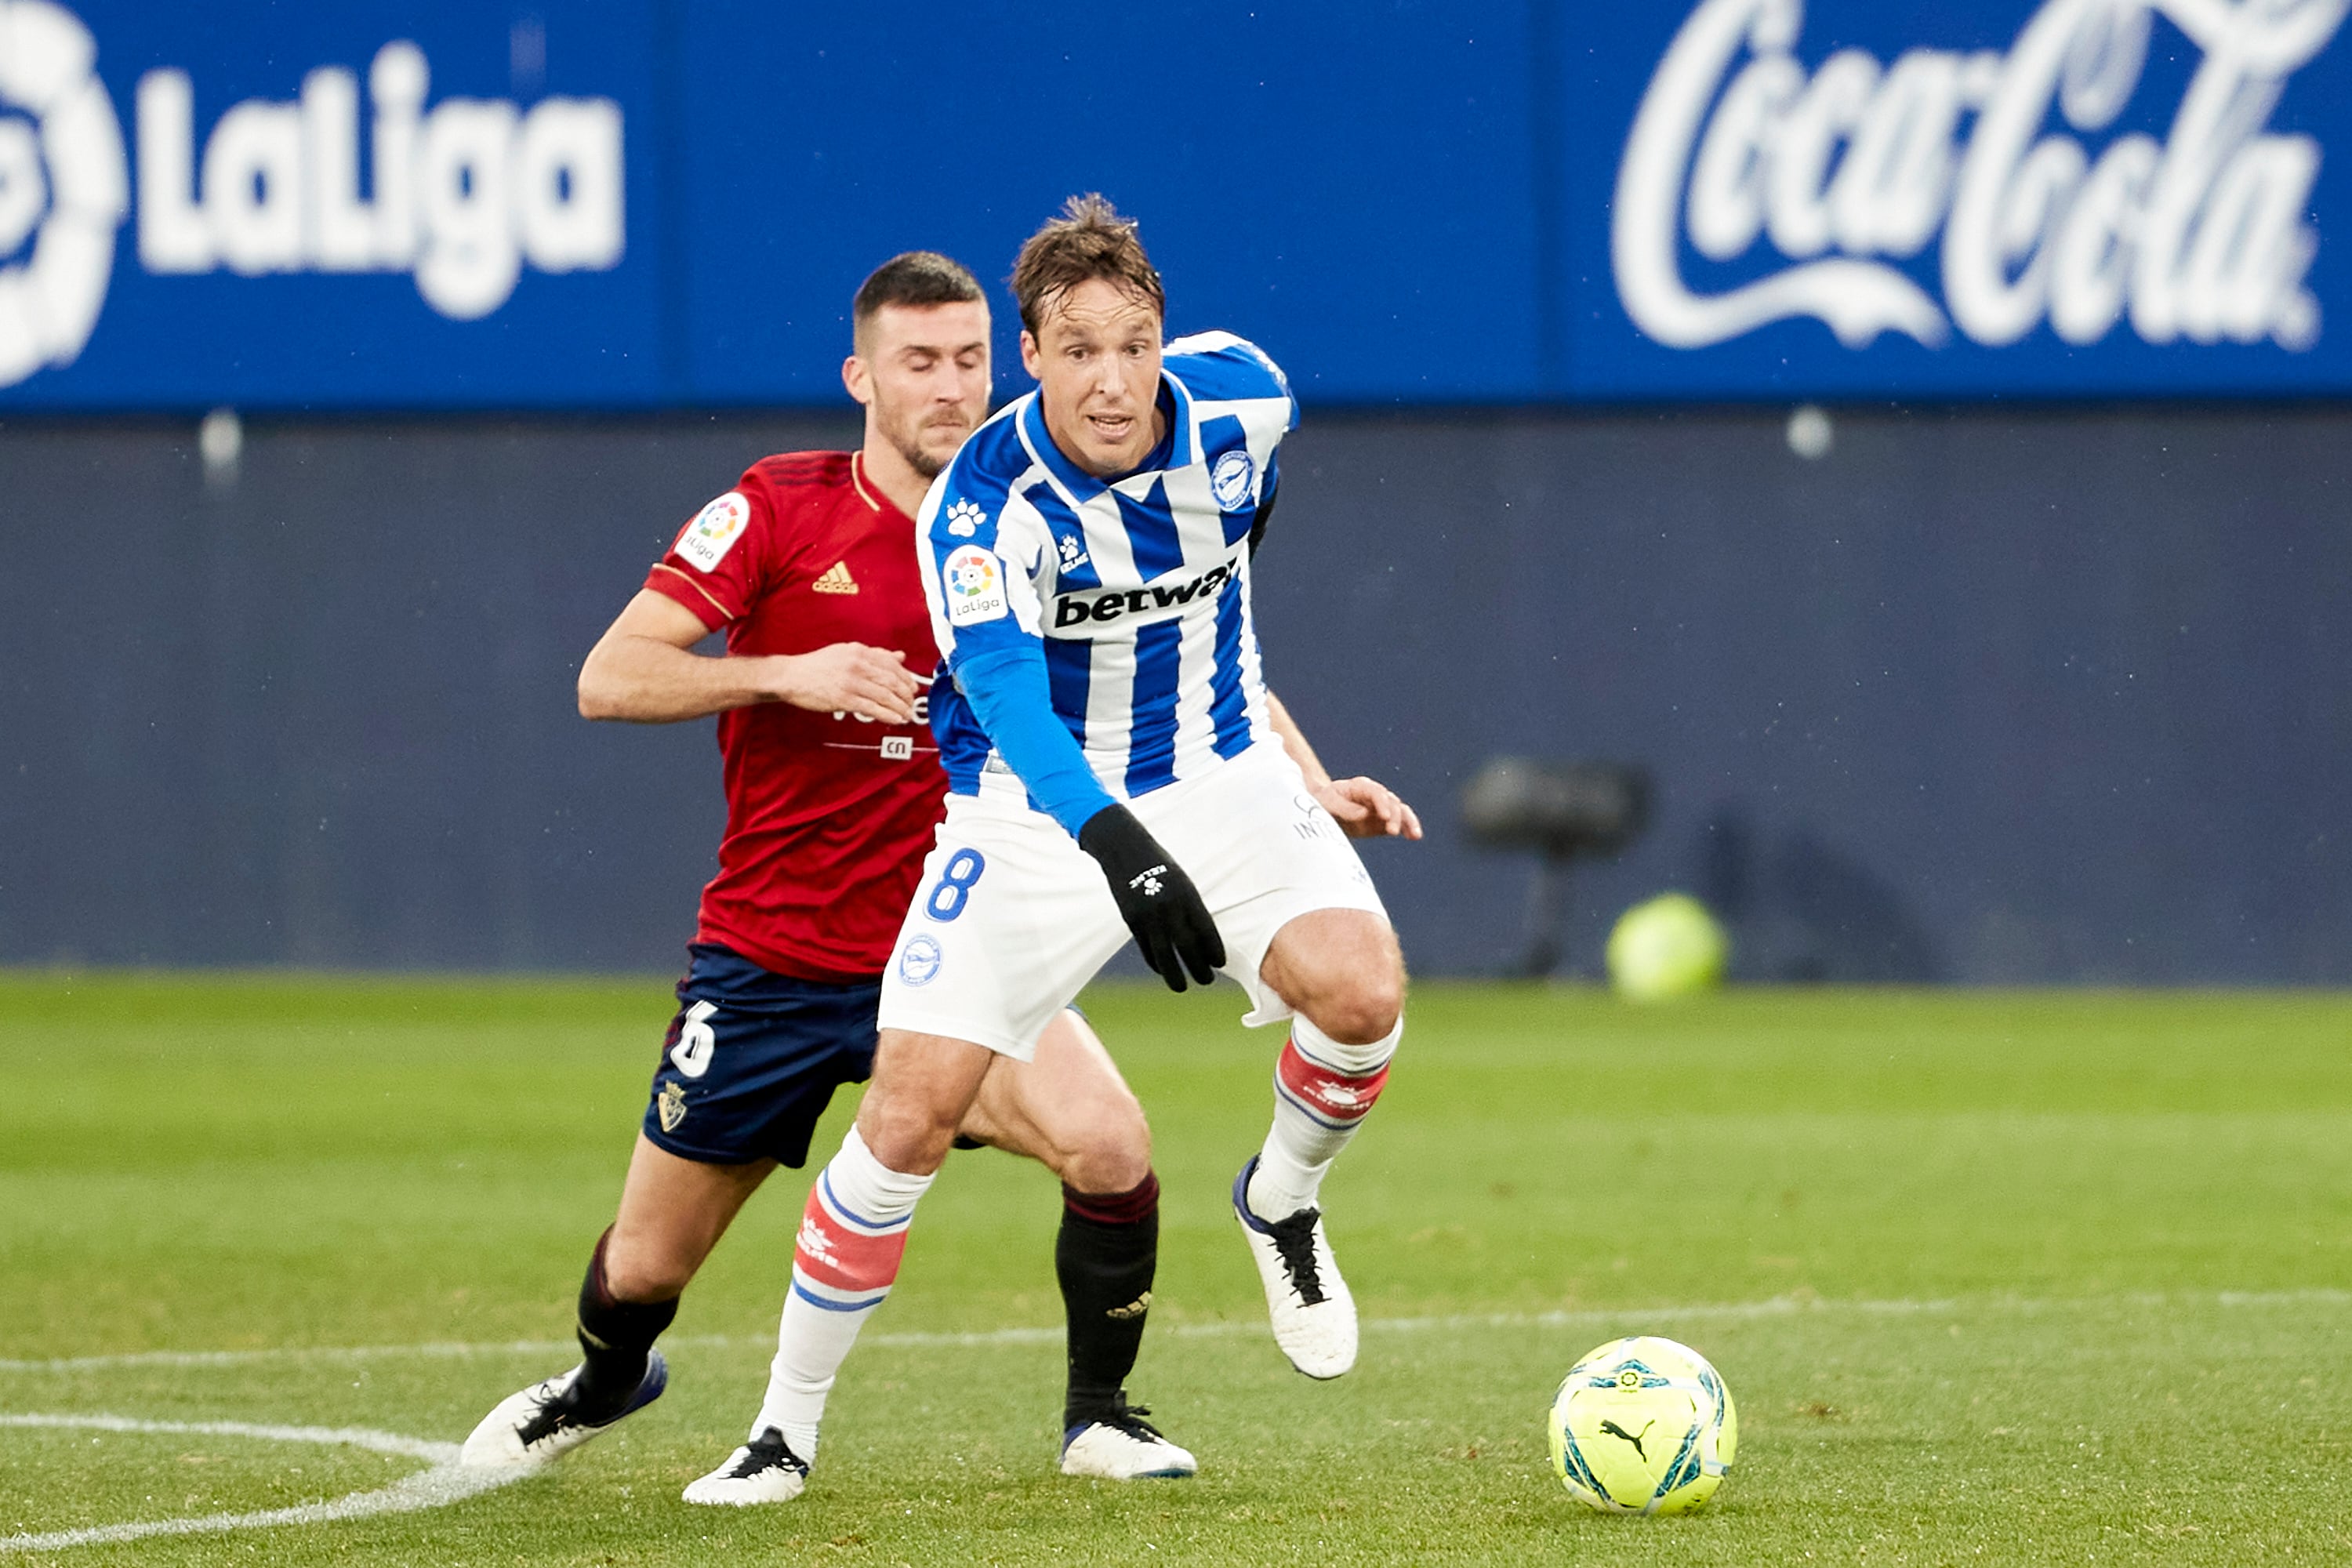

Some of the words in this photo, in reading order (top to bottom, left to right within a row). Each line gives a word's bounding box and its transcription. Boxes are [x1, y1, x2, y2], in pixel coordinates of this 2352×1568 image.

[136, 38, 624, 318] LaLiga
[956, 599, 1000, 616] LaLiga
[924, 847, 986, 924] 8
[670, 1000, 719, 1078] 6
